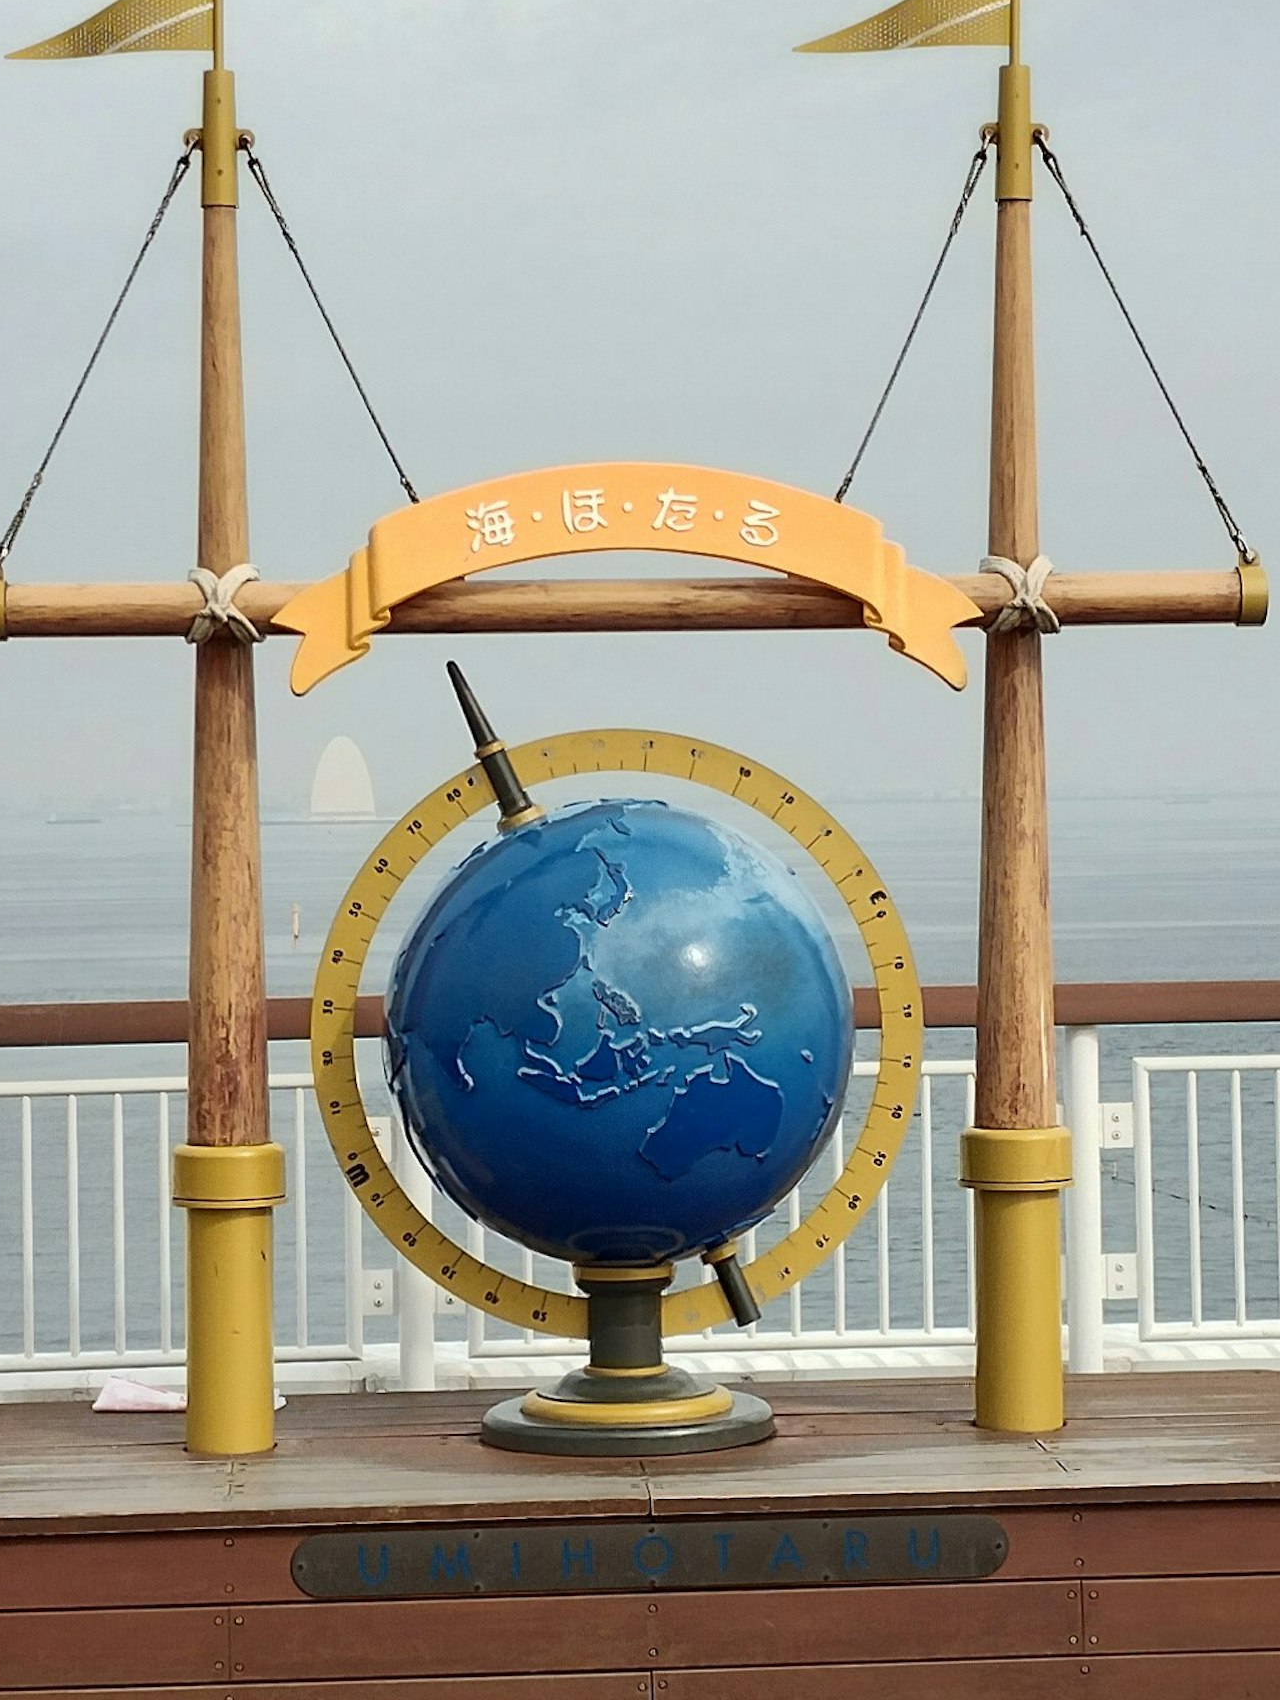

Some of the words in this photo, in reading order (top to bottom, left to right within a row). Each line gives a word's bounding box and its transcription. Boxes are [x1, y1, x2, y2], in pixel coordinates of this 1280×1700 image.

[406, 820, 422, 835] 70
[374, 858, 389, 874] 60
[348, 902, 362, 918] 50
[329, 1101, 341, 1115] 10
[873, 1151, 887, 1167] 50
[371, 1193, 384, 1208] 10
[532, 1309, 548, 1323] 50
[357, 1526, 941, 1586] UMIHOTARU
